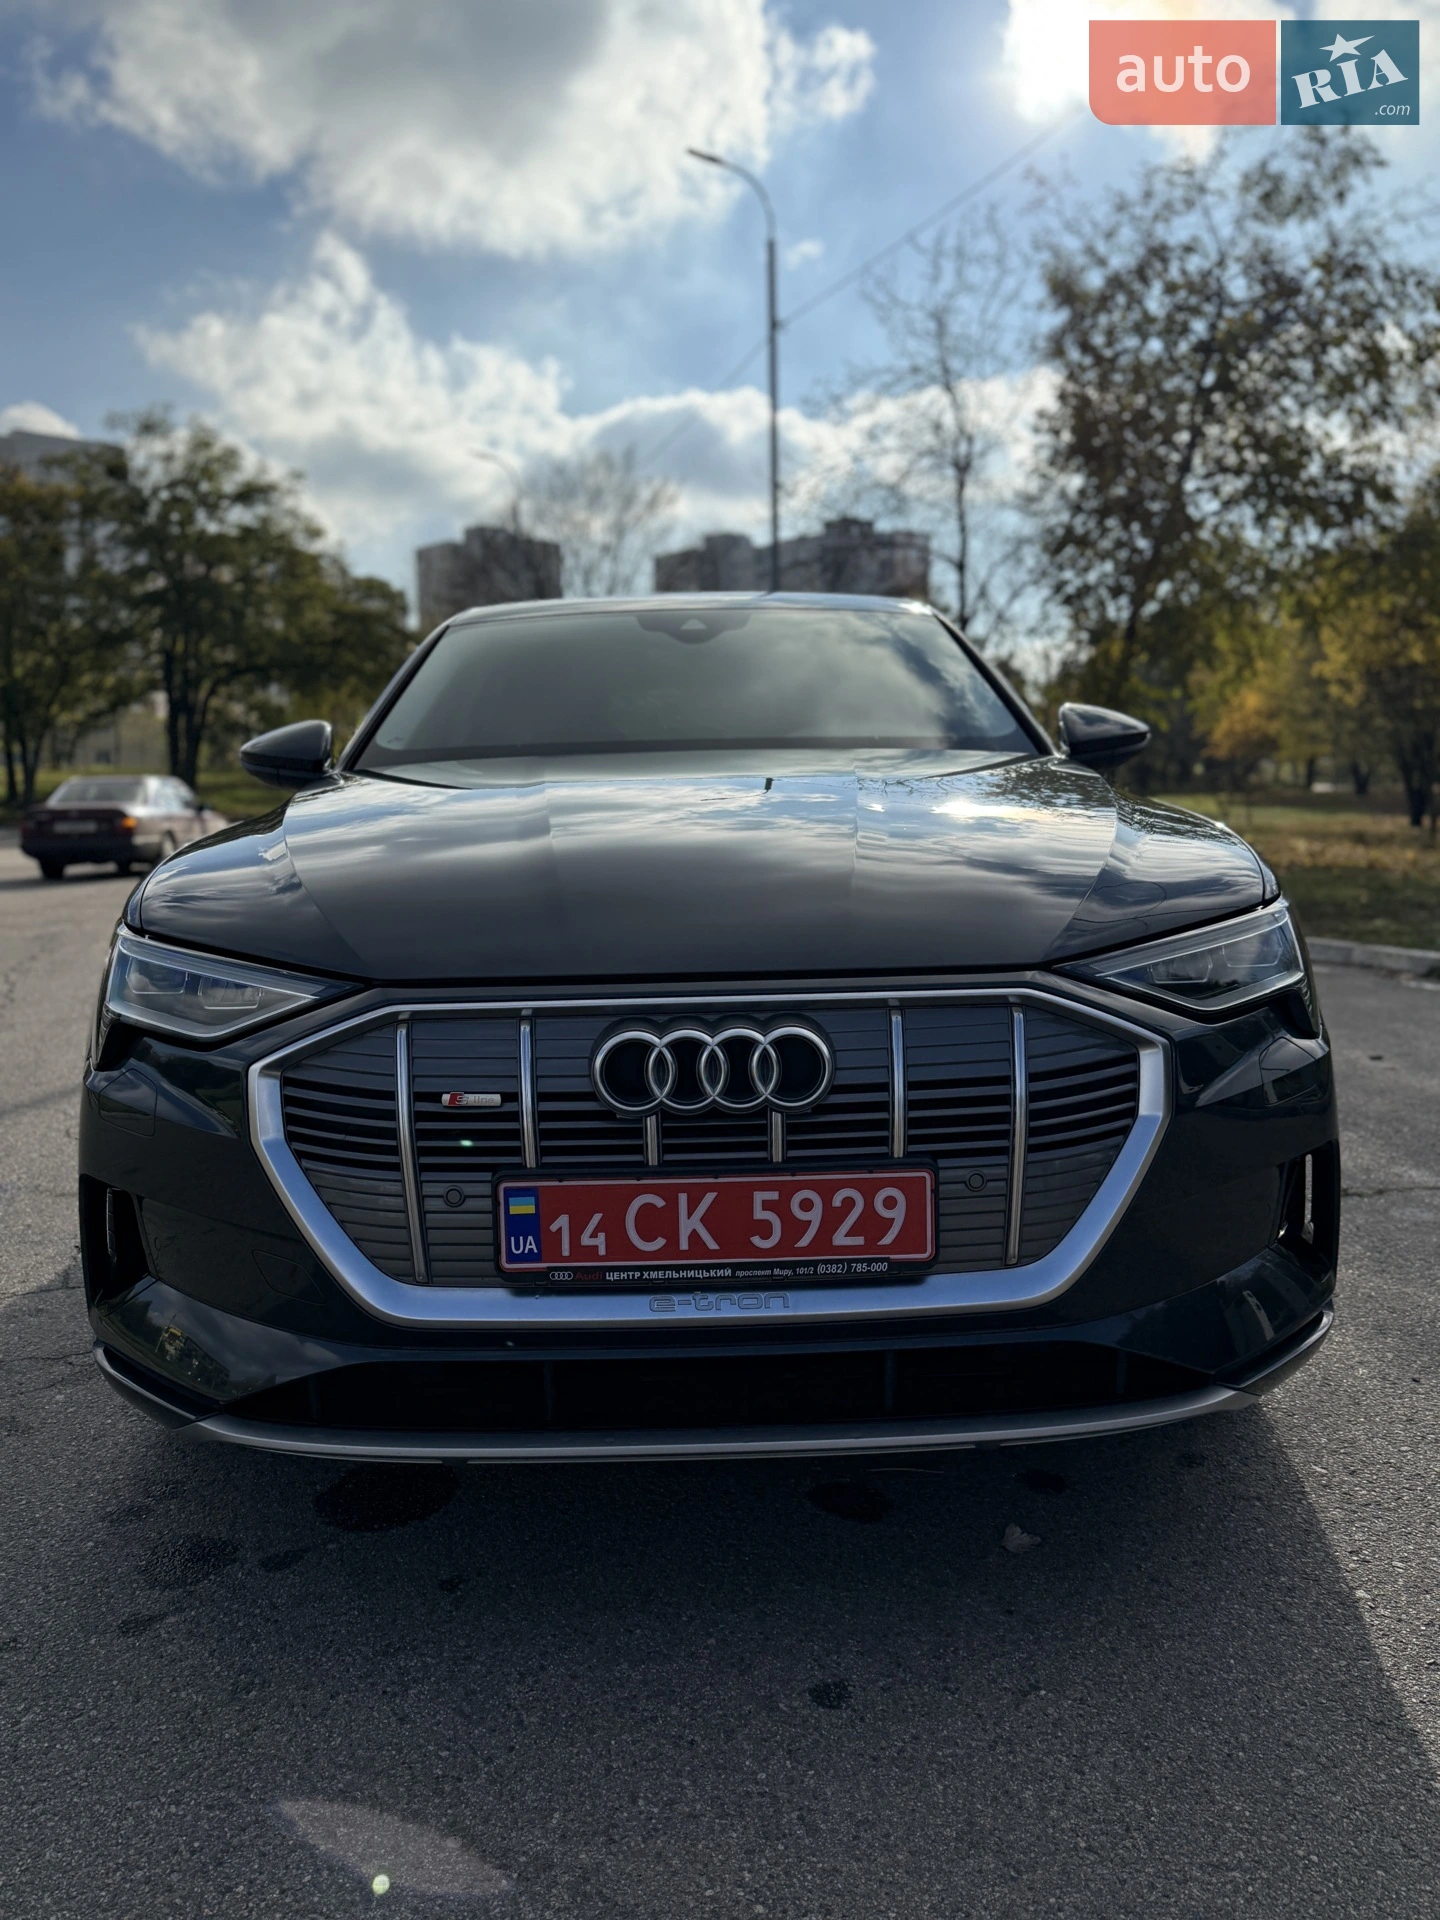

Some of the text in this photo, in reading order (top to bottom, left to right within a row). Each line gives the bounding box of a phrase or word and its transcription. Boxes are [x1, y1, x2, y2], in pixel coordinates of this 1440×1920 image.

[549, 1187, 907, 1257] 14 CK 5929
[510, 1235, 538, 1255] UA
[575, 1271, 602, 1280] Audi
[605, 1271, 641, 1281] ЦЕНТР
[642, 1268, 732, 1280] ХМЕЛЬНИЦЬКИЙ
[735, 1269, 772, 1278] проспект
[796, 1267, 815, 1275] 101/2
[817, 1262, 847, 1275] (0382)
[850, 1262, 888, 1273] 785-000
[648, 1291, 790, 1313] e-tron
